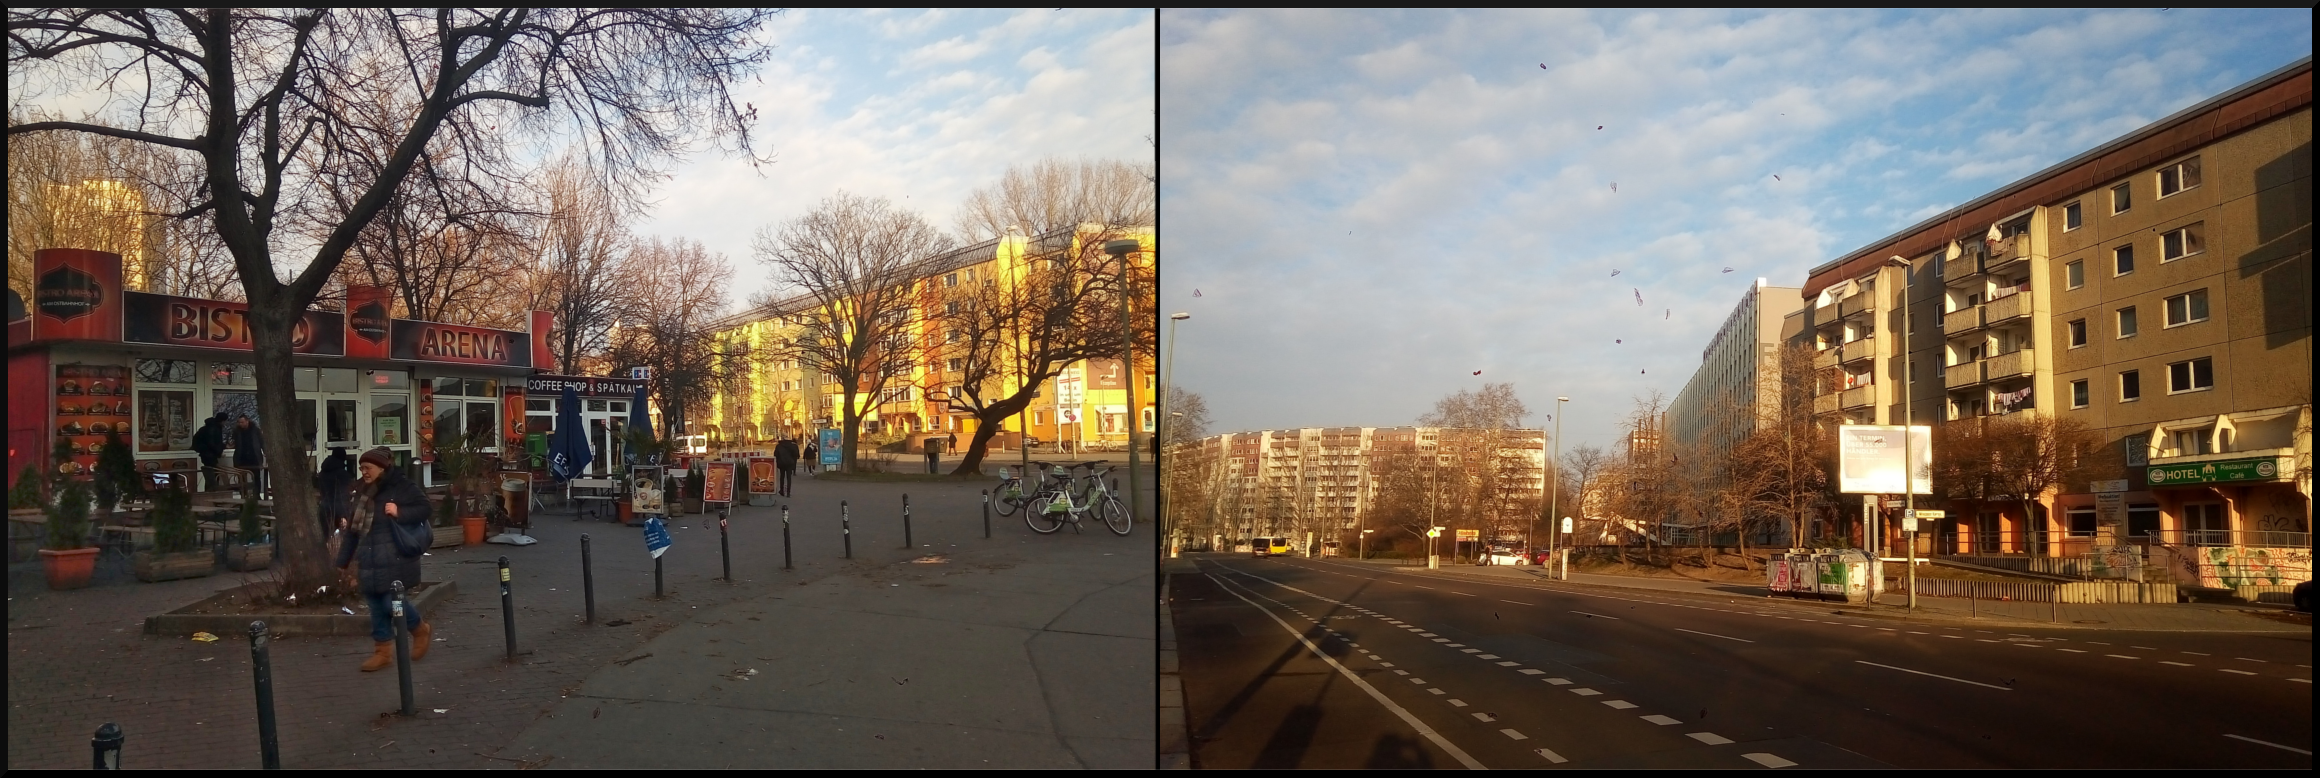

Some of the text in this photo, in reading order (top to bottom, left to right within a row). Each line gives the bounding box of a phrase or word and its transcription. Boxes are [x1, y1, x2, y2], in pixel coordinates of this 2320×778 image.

[171, 302, 311, 348] BISTO
[421, 327, 508, 361] ARENA
[528, 380, 562, 391] COFFEE
[589, 383, 595, 392] &
[1846, 440, 1864, 448] ÜBER
[1846, 447, 1881, 455] HÄNDLER.
[2166, 469, 2201, 480] HOTEL
